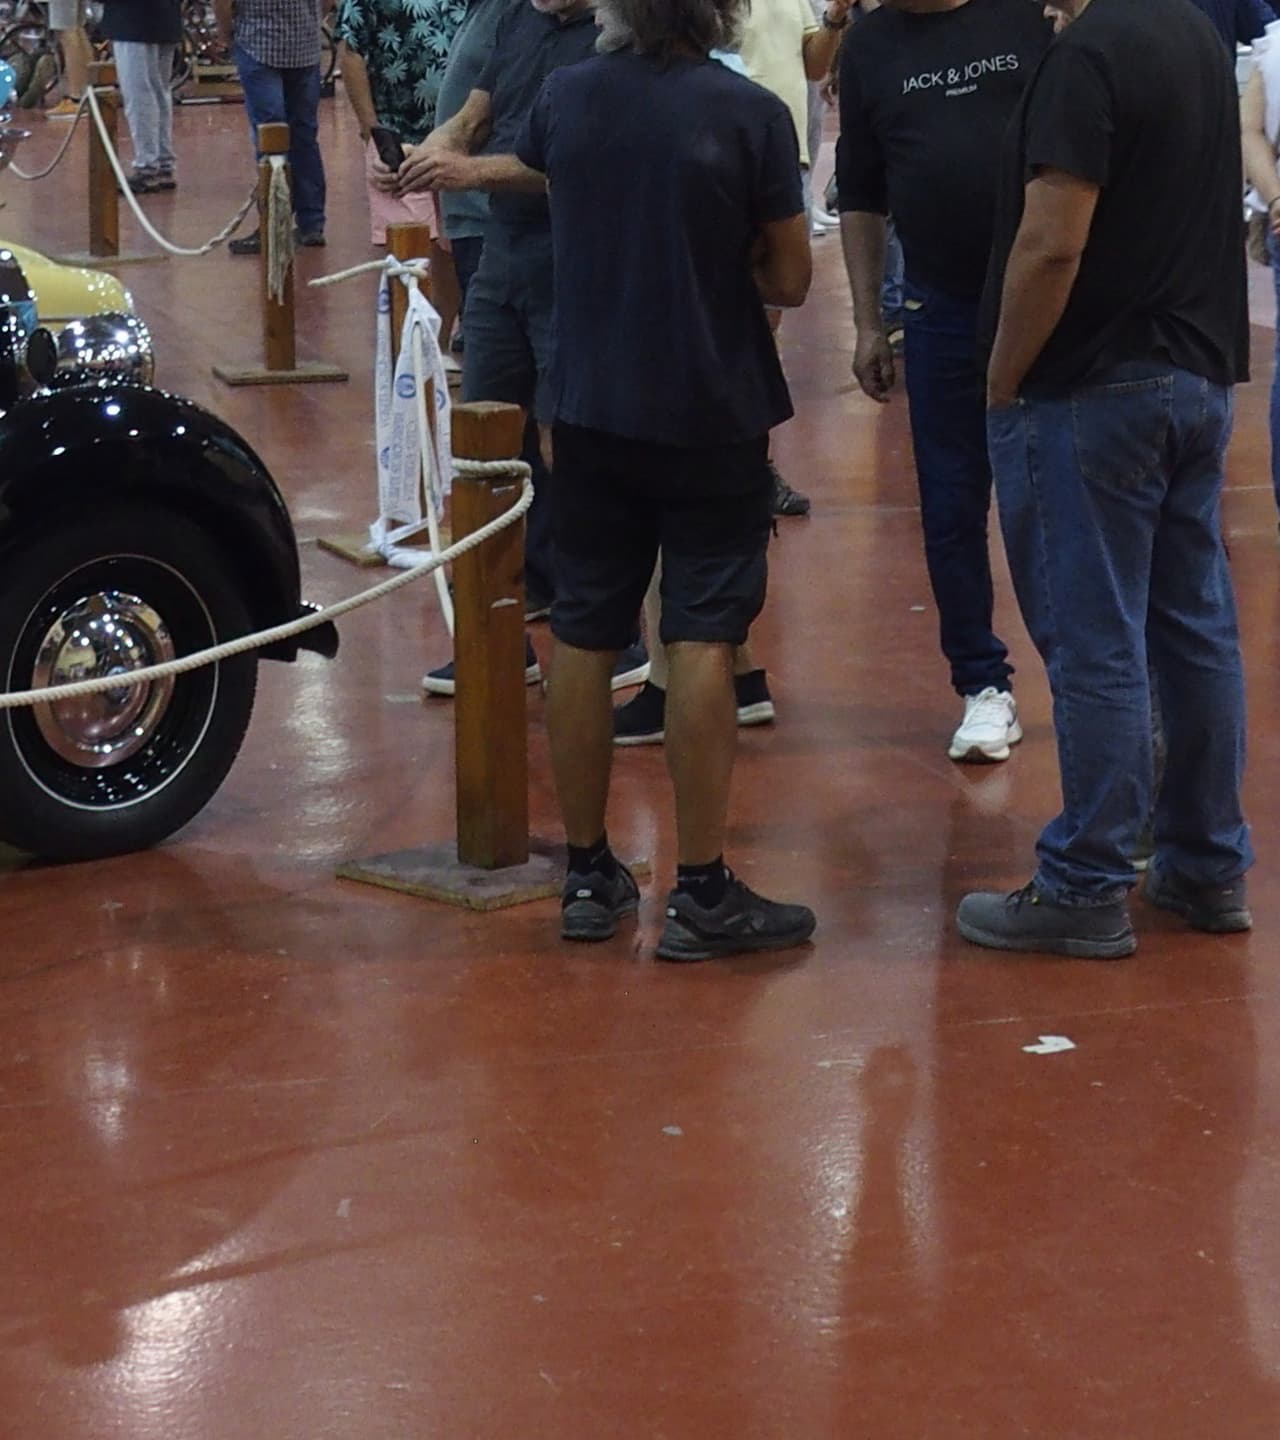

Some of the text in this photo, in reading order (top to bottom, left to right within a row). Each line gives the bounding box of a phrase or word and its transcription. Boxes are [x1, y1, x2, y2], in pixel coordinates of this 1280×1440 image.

[902, 53, 1020, 95] JACK & JONES
